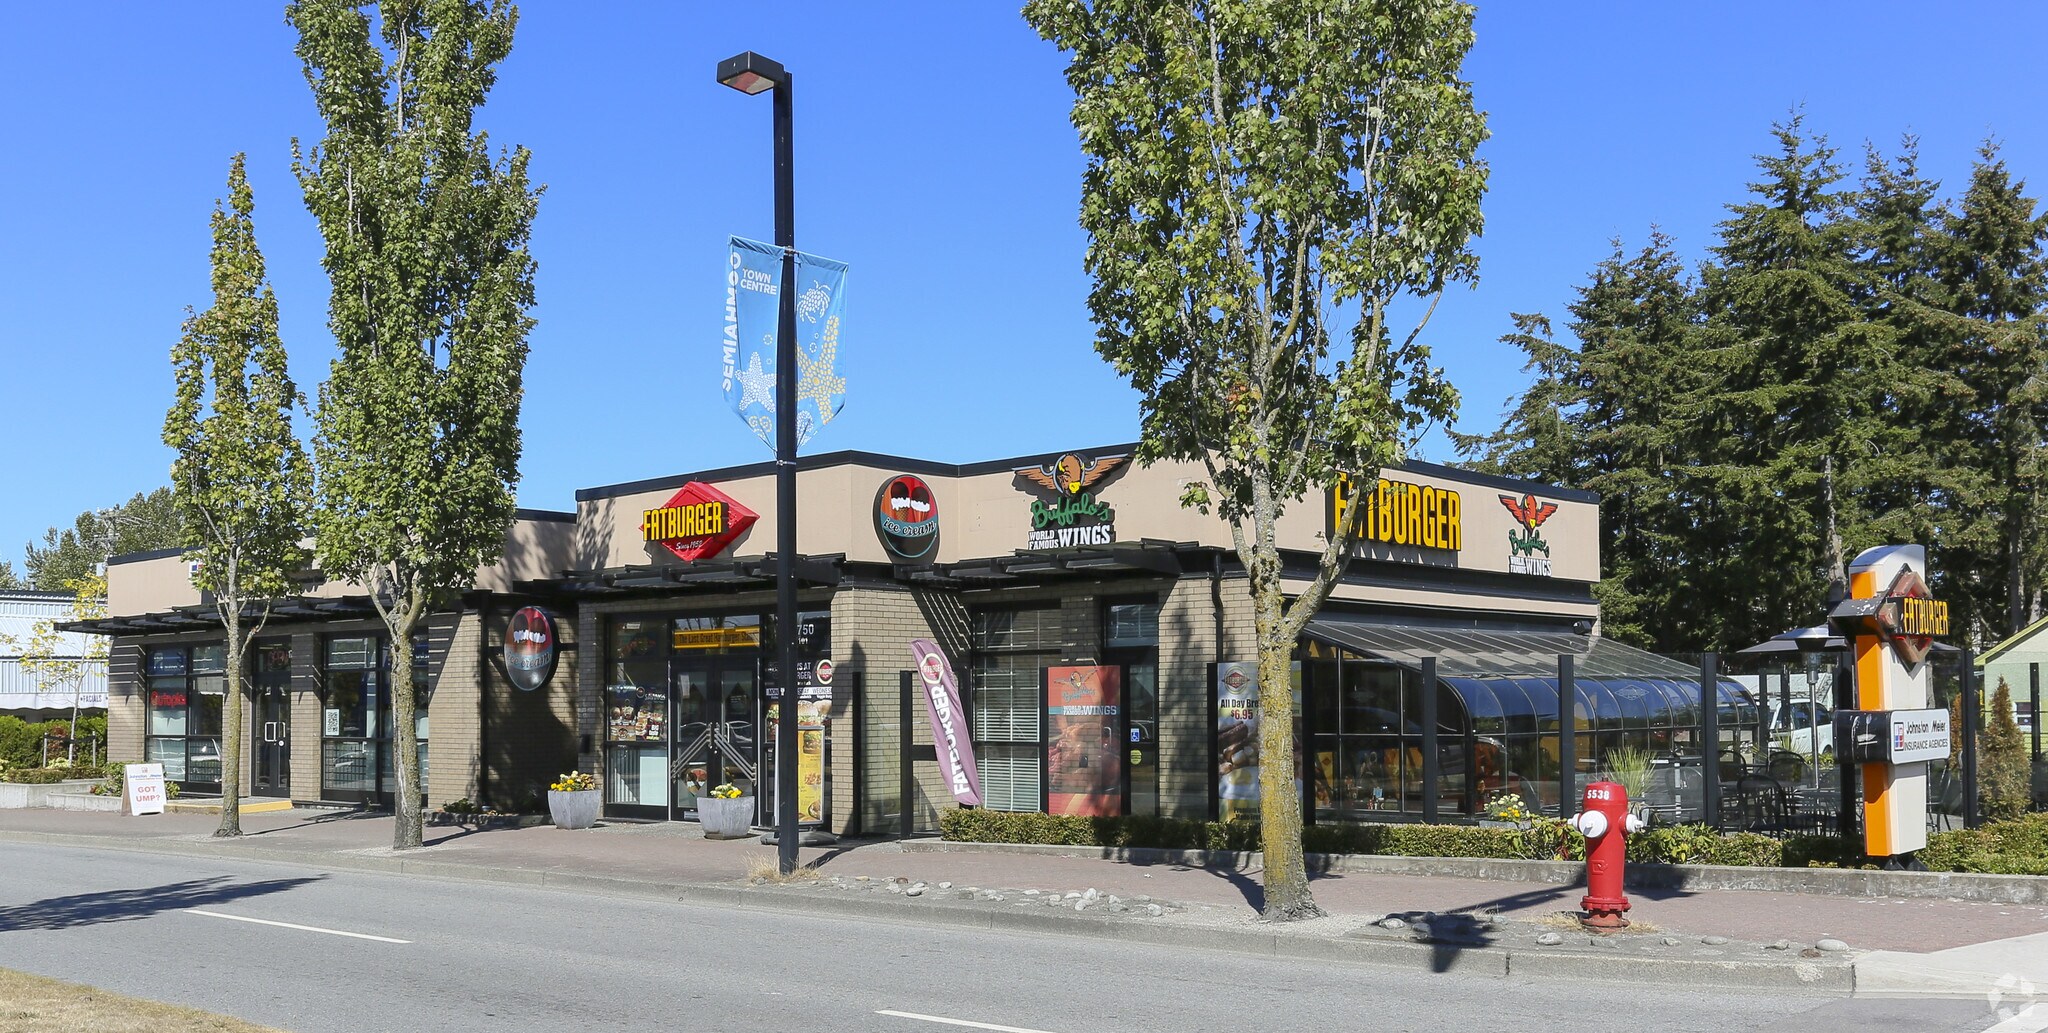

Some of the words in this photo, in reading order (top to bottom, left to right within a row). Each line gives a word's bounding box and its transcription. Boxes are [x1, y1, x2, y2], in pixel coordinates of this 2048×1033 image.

[742, 268, 771, 283] TOWN
[740, 280, 777, 295] CENTRE
[722, 251, 741, 392] SEMIAHMOO
[1031, 493, 1109, 528] Buffalo's
[1334, 472, 1462, 551] FTBURGER
[643, 502, 722, 541] FATBURGER
[884, 518, 901, 533] ice
[902, 521, 937, 536] cream
[1029, 530, 1054, 541] WORLD
[1029, 539, 1059, 550] FAMOUS
[1057, 524, 1111, 547] WINGS
[1525, 558, 1552, 577] WINGS
[1904, 597, 1949, 635] FATBURGER
[1083, 706, 1117, 715] WINGS
[1221, 699, 1231, 708] All
[1232, 699, 1245, 709] Day
[1231, 709, 1253, 720] $6.95
[931, 684, 970, 796] FATBURGER
